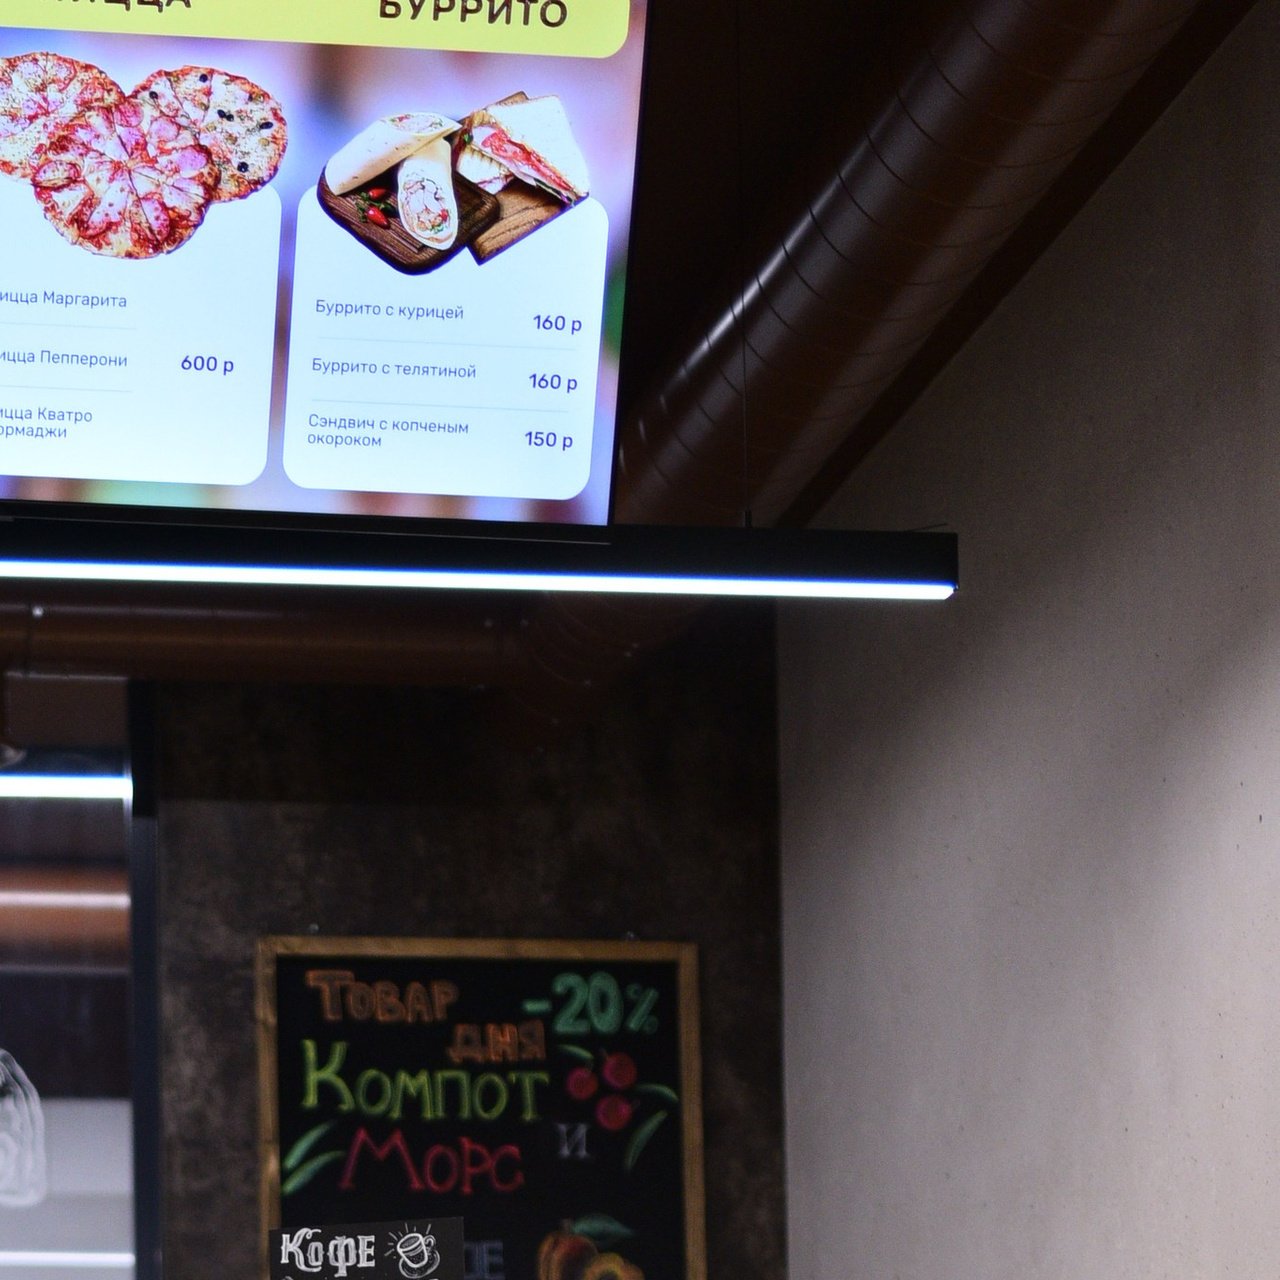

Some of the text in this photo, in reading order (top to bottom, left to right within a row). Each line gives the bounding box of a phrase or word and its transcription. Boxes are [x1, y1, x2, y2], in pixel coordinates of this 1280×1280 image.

[42, 290, 127, 310] Маргарита
[315, 298, 464, 321] Буррито с курицей
[532, 314, 583, 336] 160 р
[40, 349, 128, 369] Пепперони
[180, 354, 235, 377] 600 р
[311, 357, 477, 379] Буррито с телятиной
[528, 372, 578, 395] 160 р
[37, 406, 93, 425] Кватро
[308, 413, 469, 434] Сэндвич с копченым
[307, 433, 382, 449] окороком
[524, 430, 574, 452] 150 р
